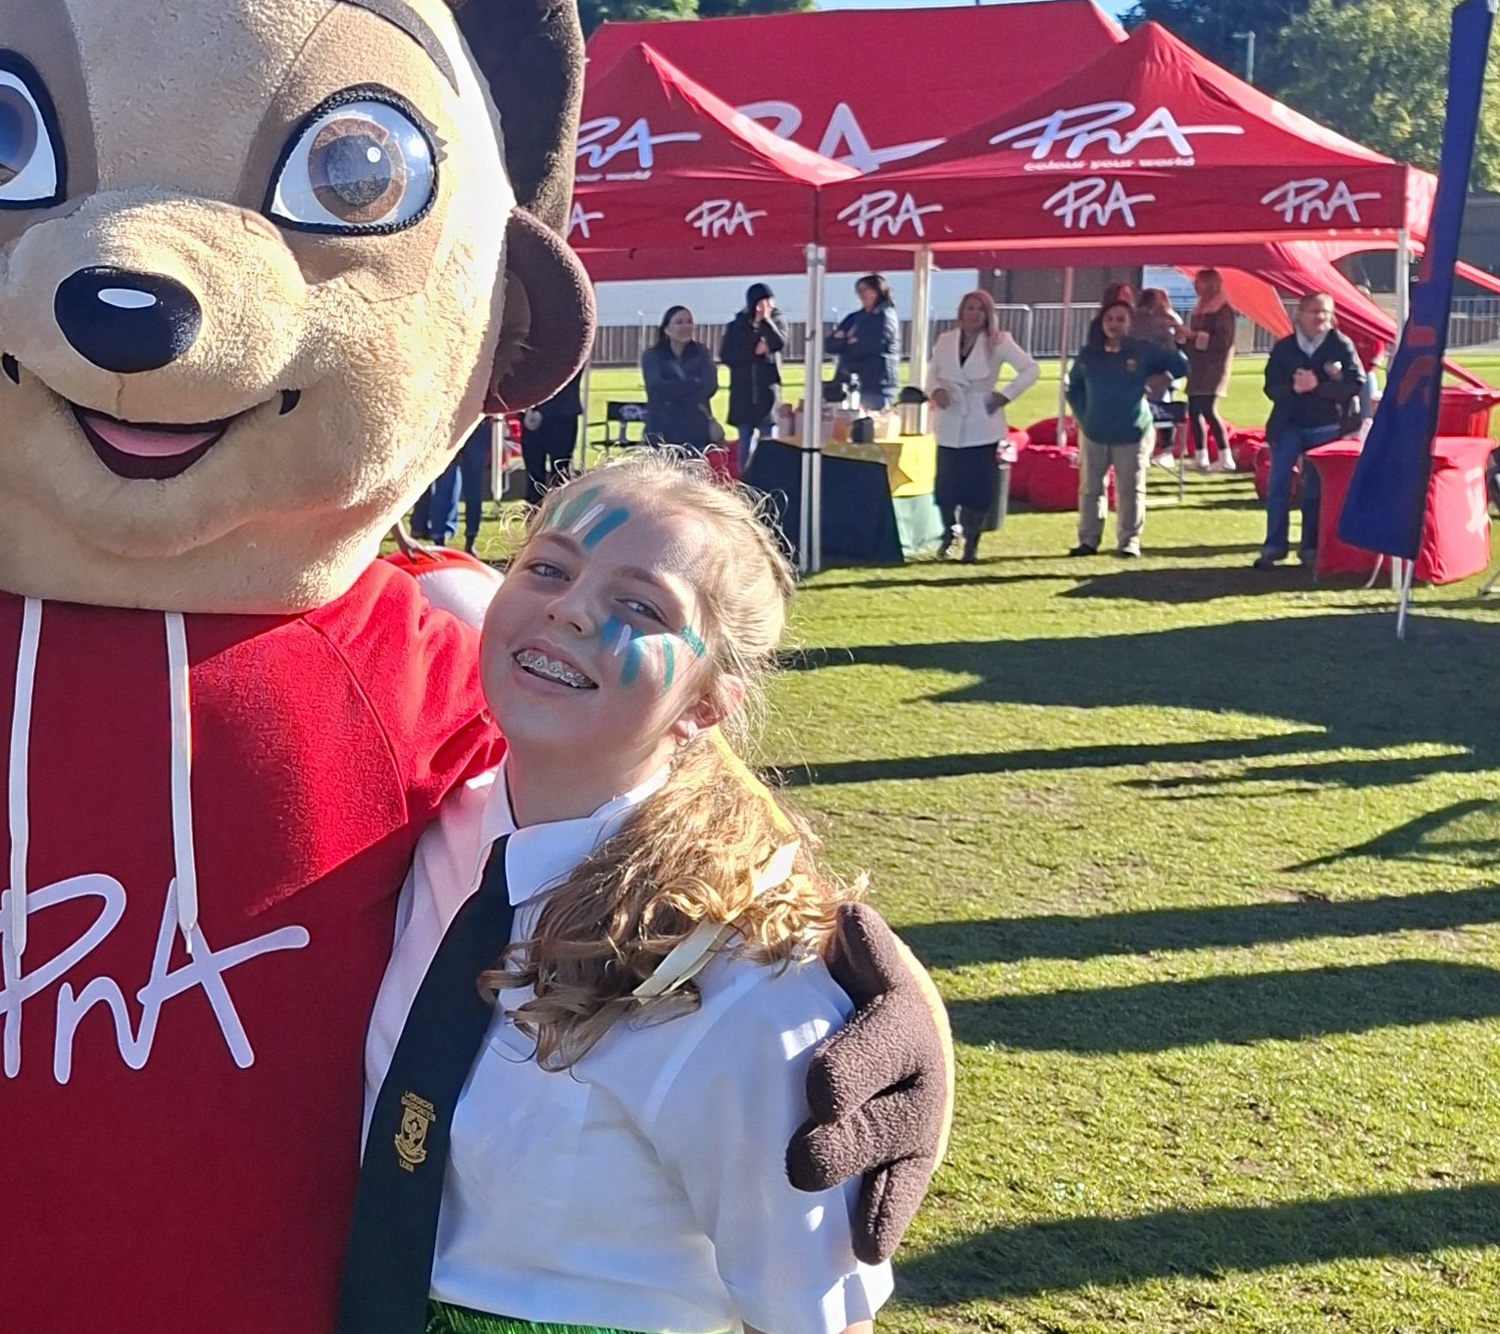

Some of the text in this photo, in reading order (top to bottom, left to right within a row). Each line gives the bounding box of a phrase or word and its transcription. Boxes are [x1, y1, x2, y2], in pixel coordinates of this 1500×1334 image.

[988, 101, 1244, 159] PnA
[685, 199, 768, 238] PnA
[837, 190, 944, 239] PnA
[1042, 177, 1156, 229] PnA
[1260, 177, 1382, 224] PnA
